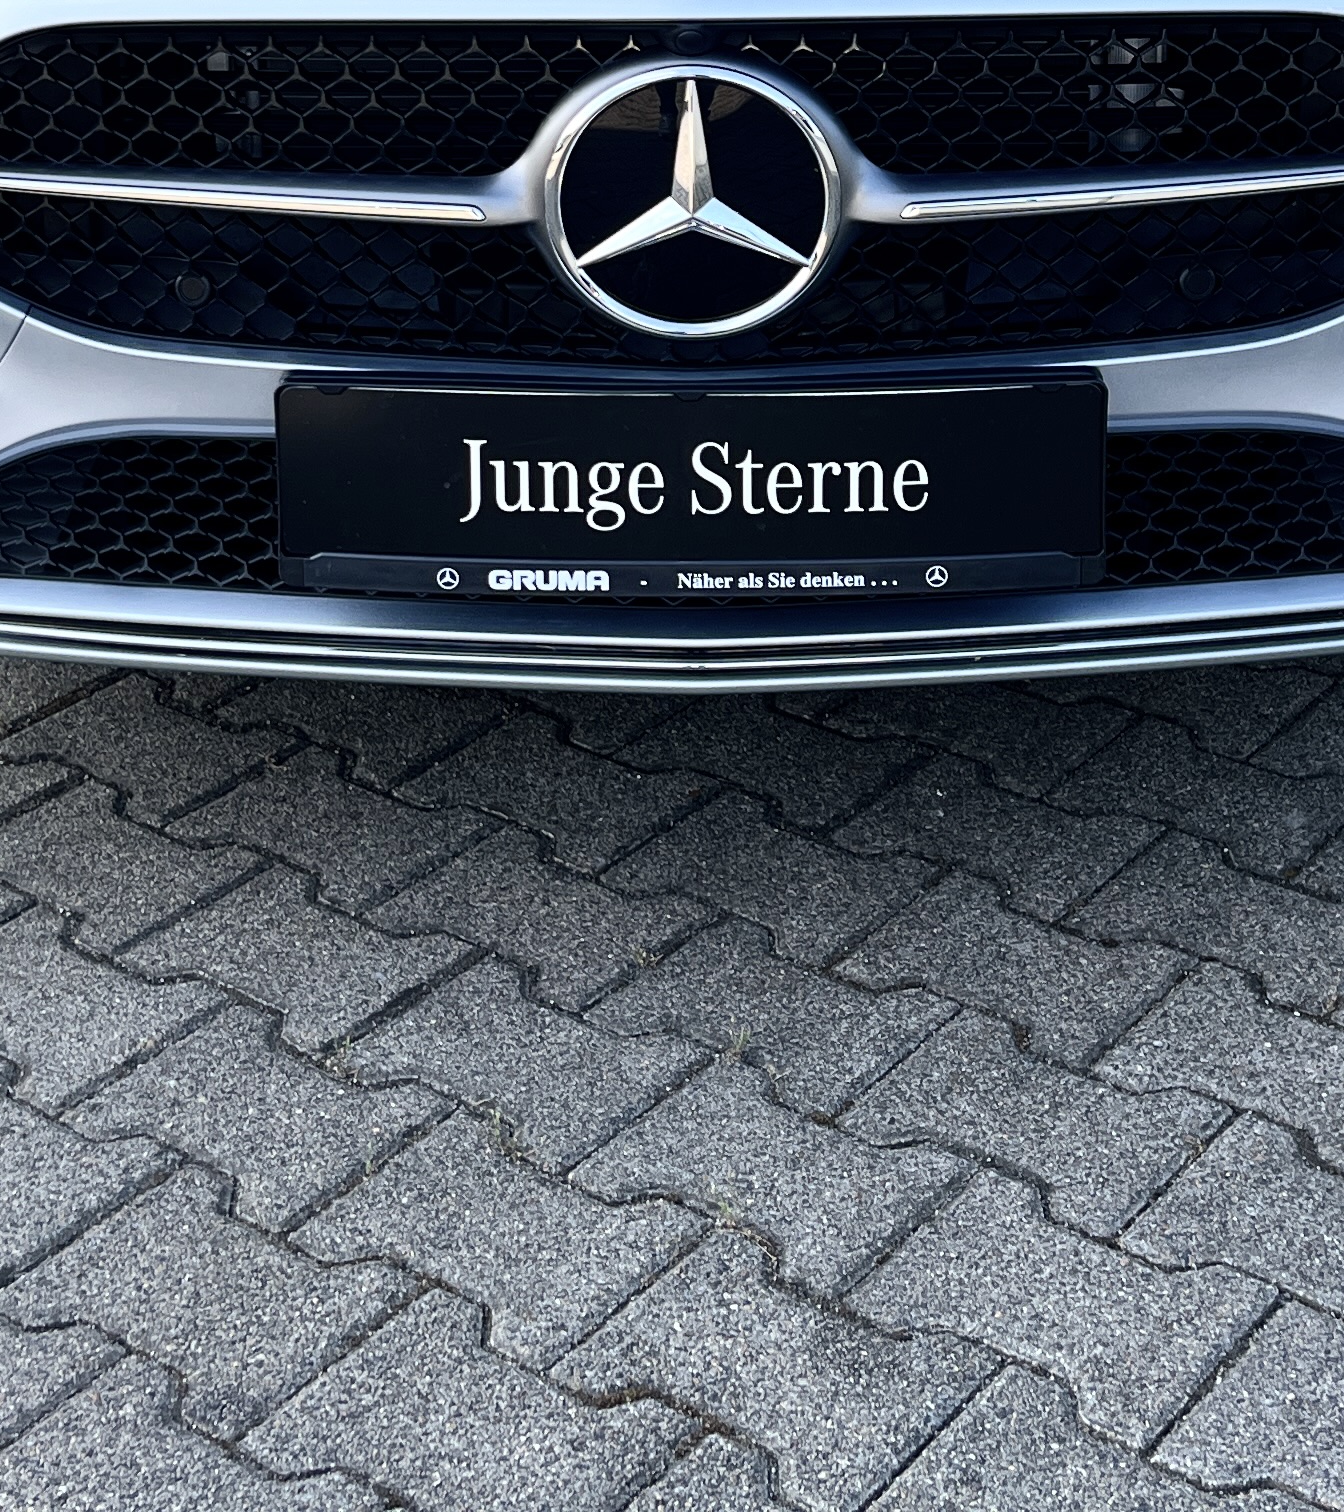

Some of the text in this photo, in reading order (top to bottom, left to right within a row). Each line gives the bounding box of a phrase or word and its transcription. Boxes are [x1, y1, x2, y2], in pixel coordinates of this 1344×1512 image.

[459, 438, 929, 532] Junge Sterne
[487, 569, 610, 591] GRUMA
[677, 572, 734, 589] Näher
[737, 572, 764, 588] als
[767, 571, 796, 588] Sie
[799, 571, 866, 588] denken
